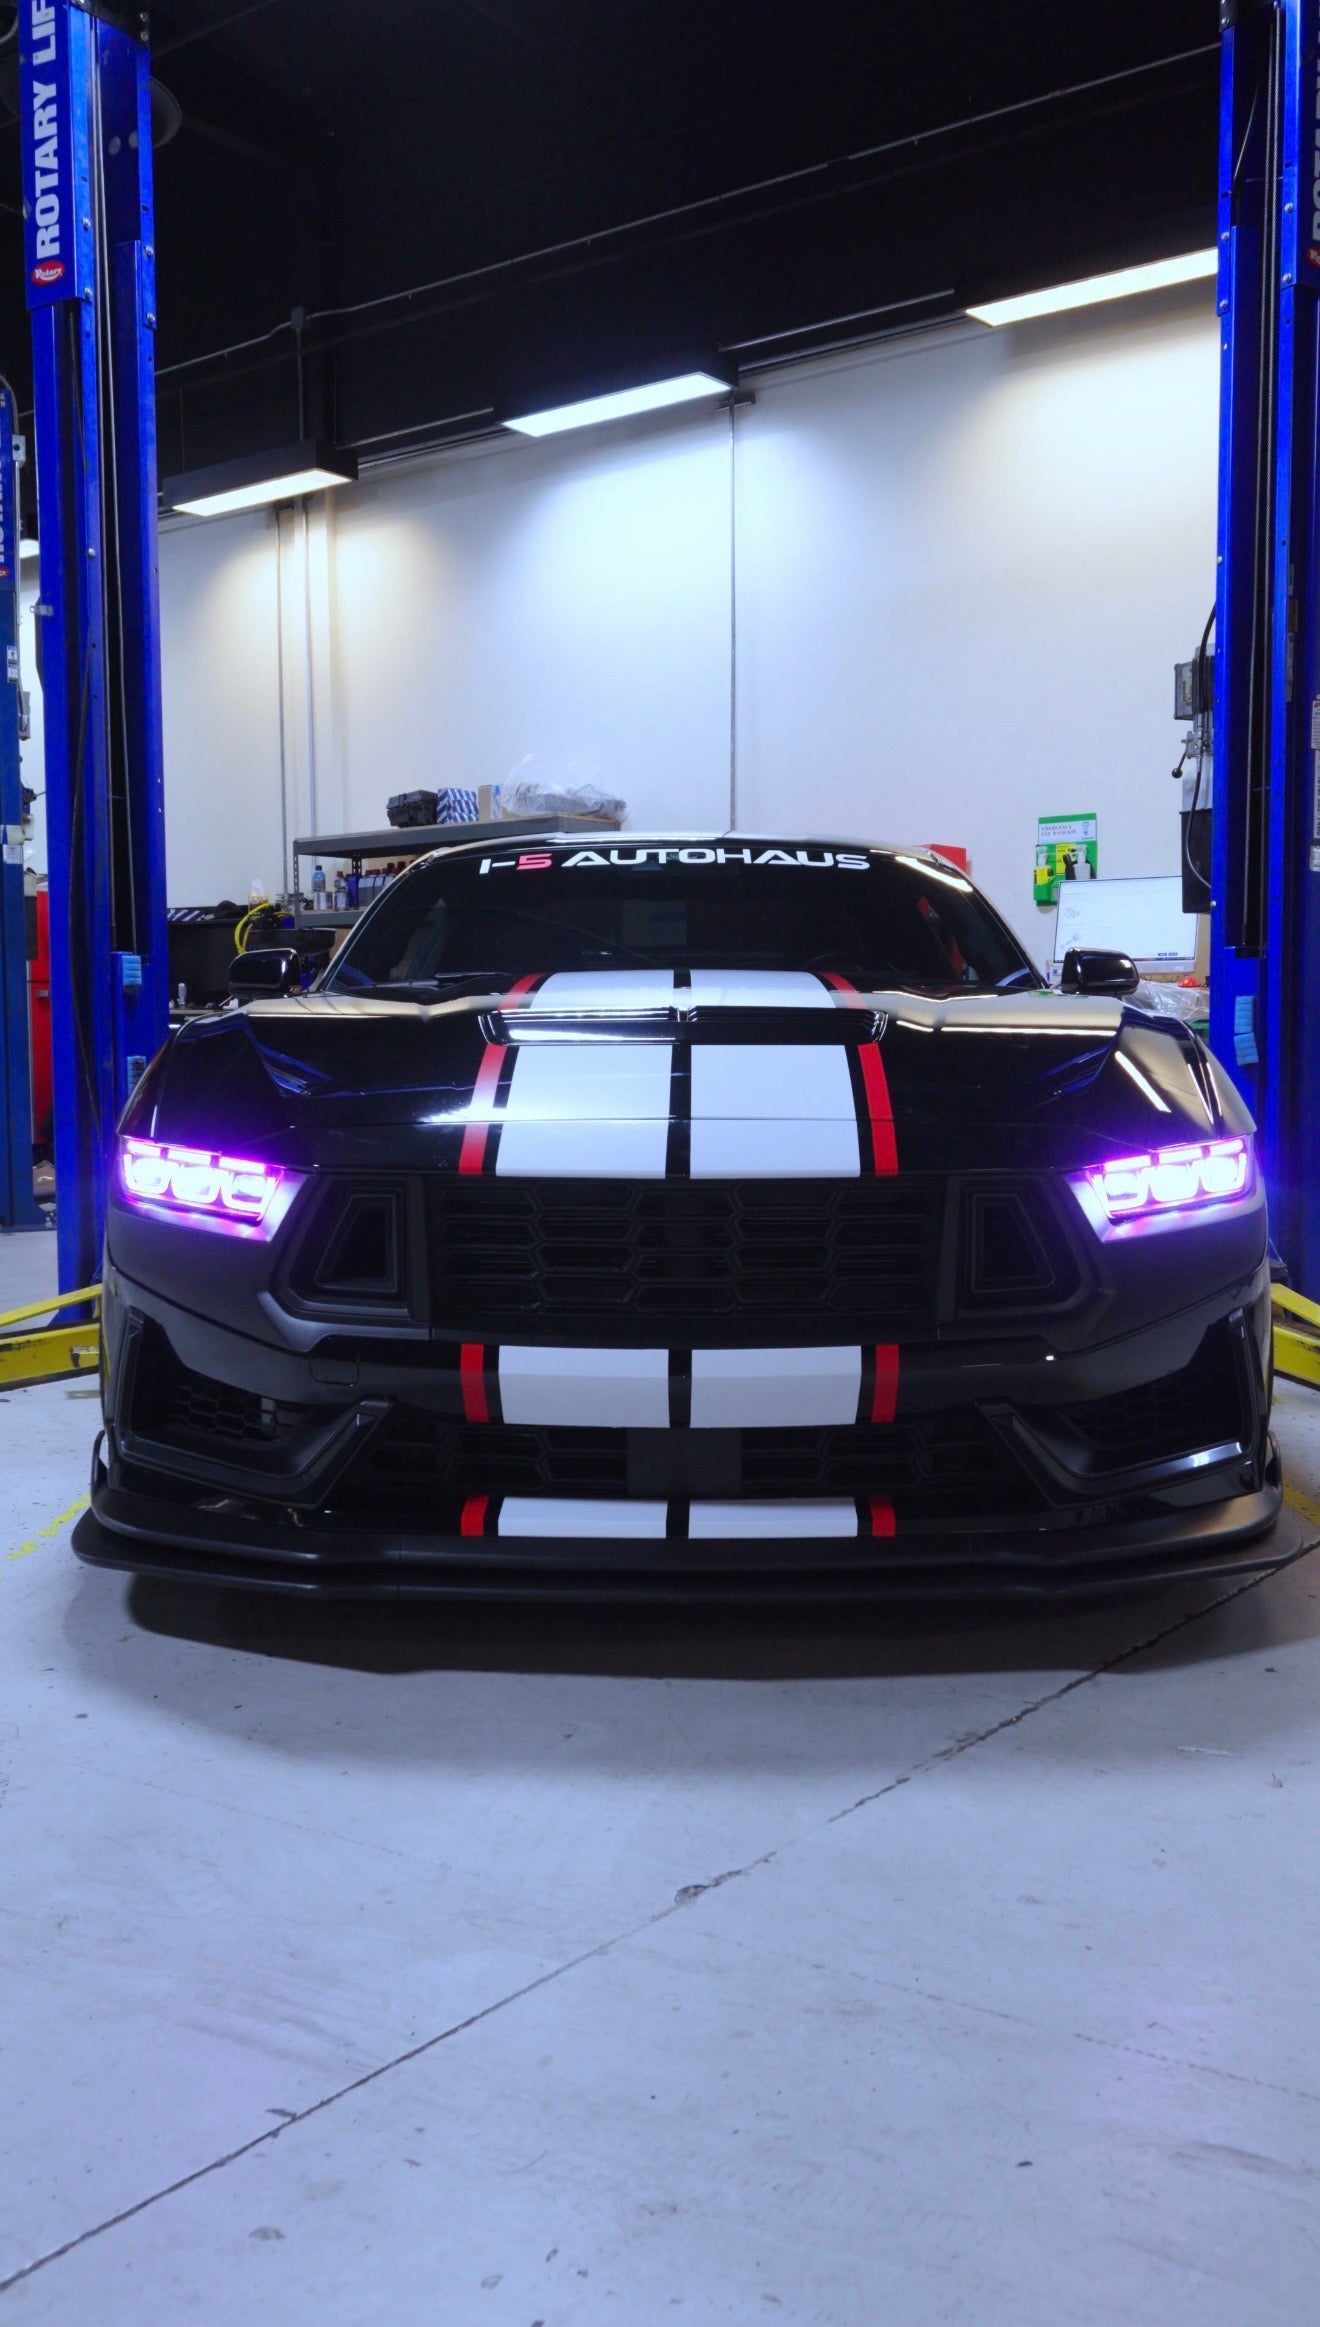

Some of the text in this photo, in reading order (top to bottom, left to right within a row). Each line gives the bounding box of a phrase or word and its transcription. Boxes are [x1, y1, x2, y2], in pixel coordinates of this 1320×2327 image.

[33, 80, 60, 259] ROTARY
[479, 848, 870, 875] I-5 AUTOHAUS
